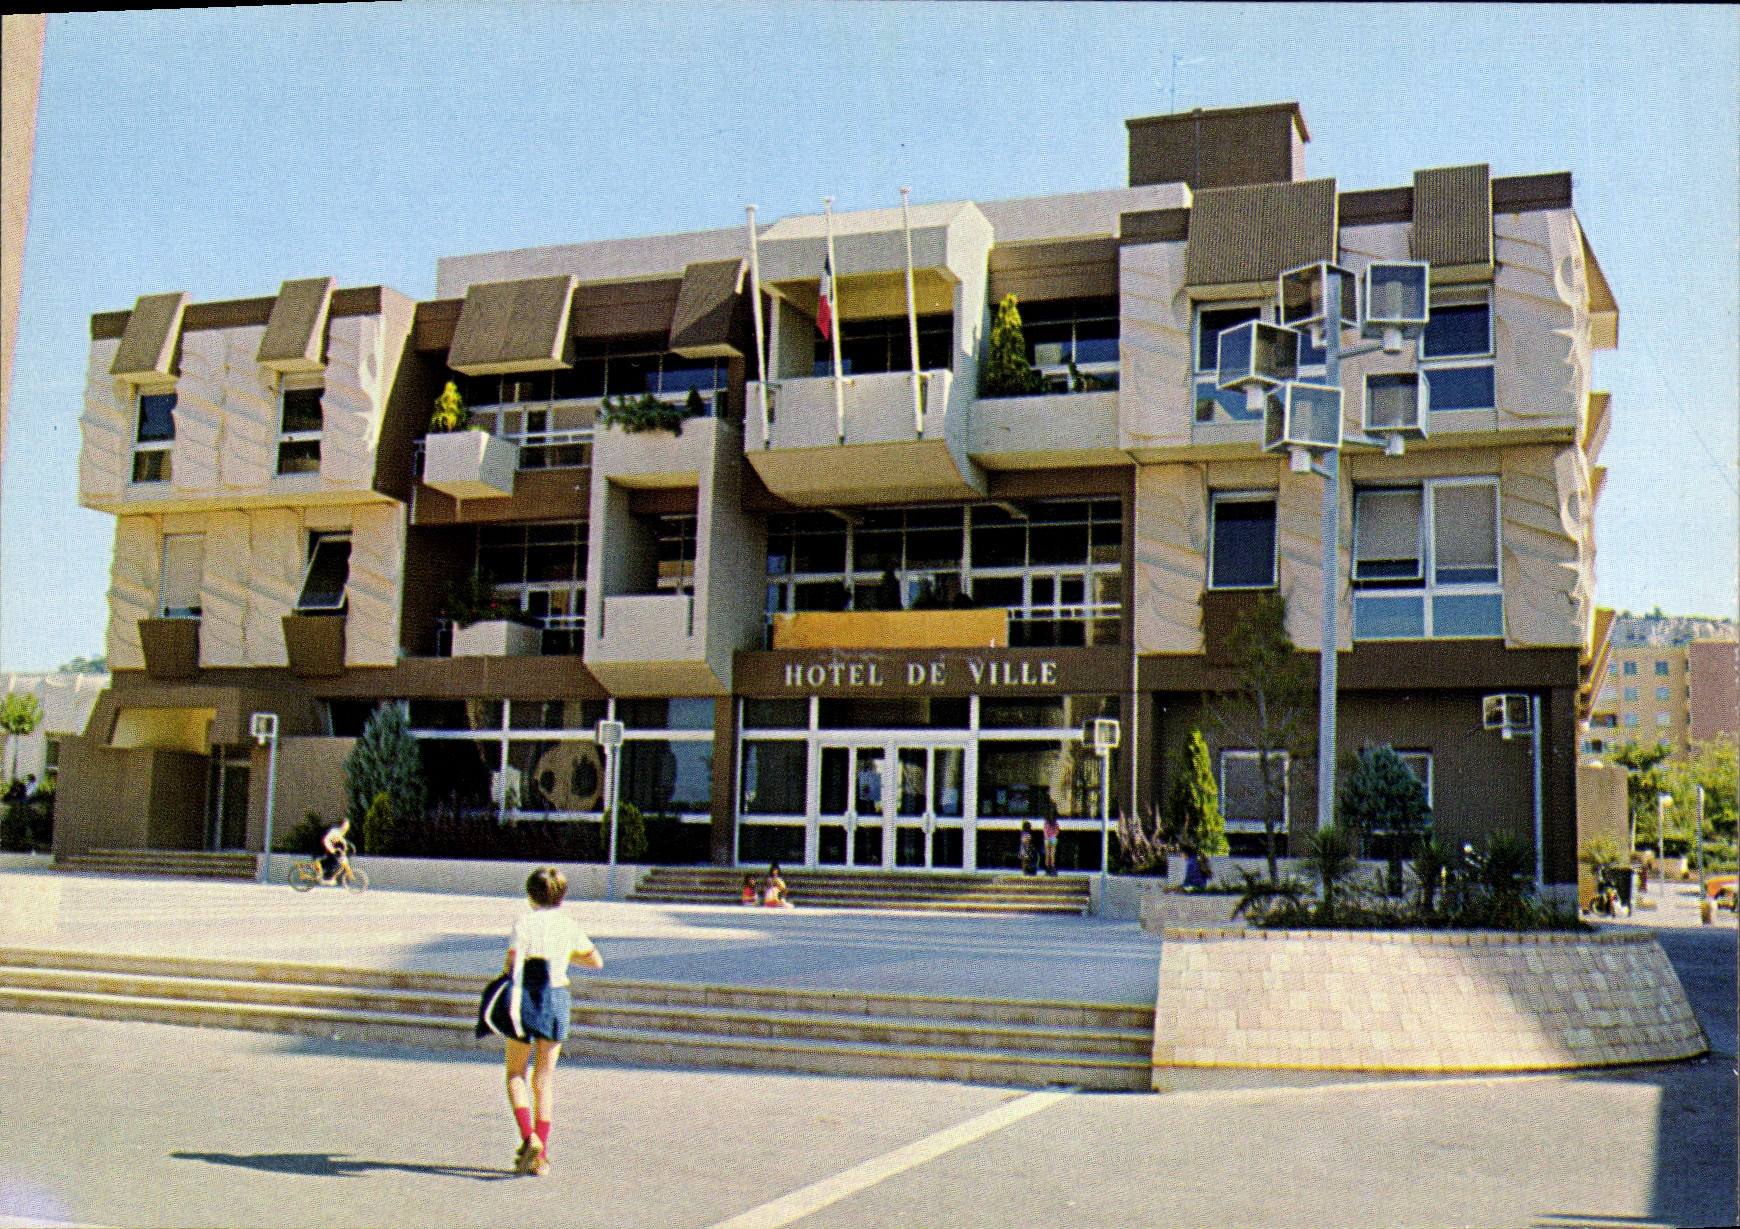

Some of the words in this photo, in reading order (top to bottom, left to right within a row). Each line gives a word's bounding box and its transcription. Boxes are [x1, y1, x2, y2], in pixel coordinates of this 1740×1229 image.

[784, 662, 885, 688] HOTEL
[906, 660, 946, 686] DE
[967, 660, 1058, 686] VILLE
